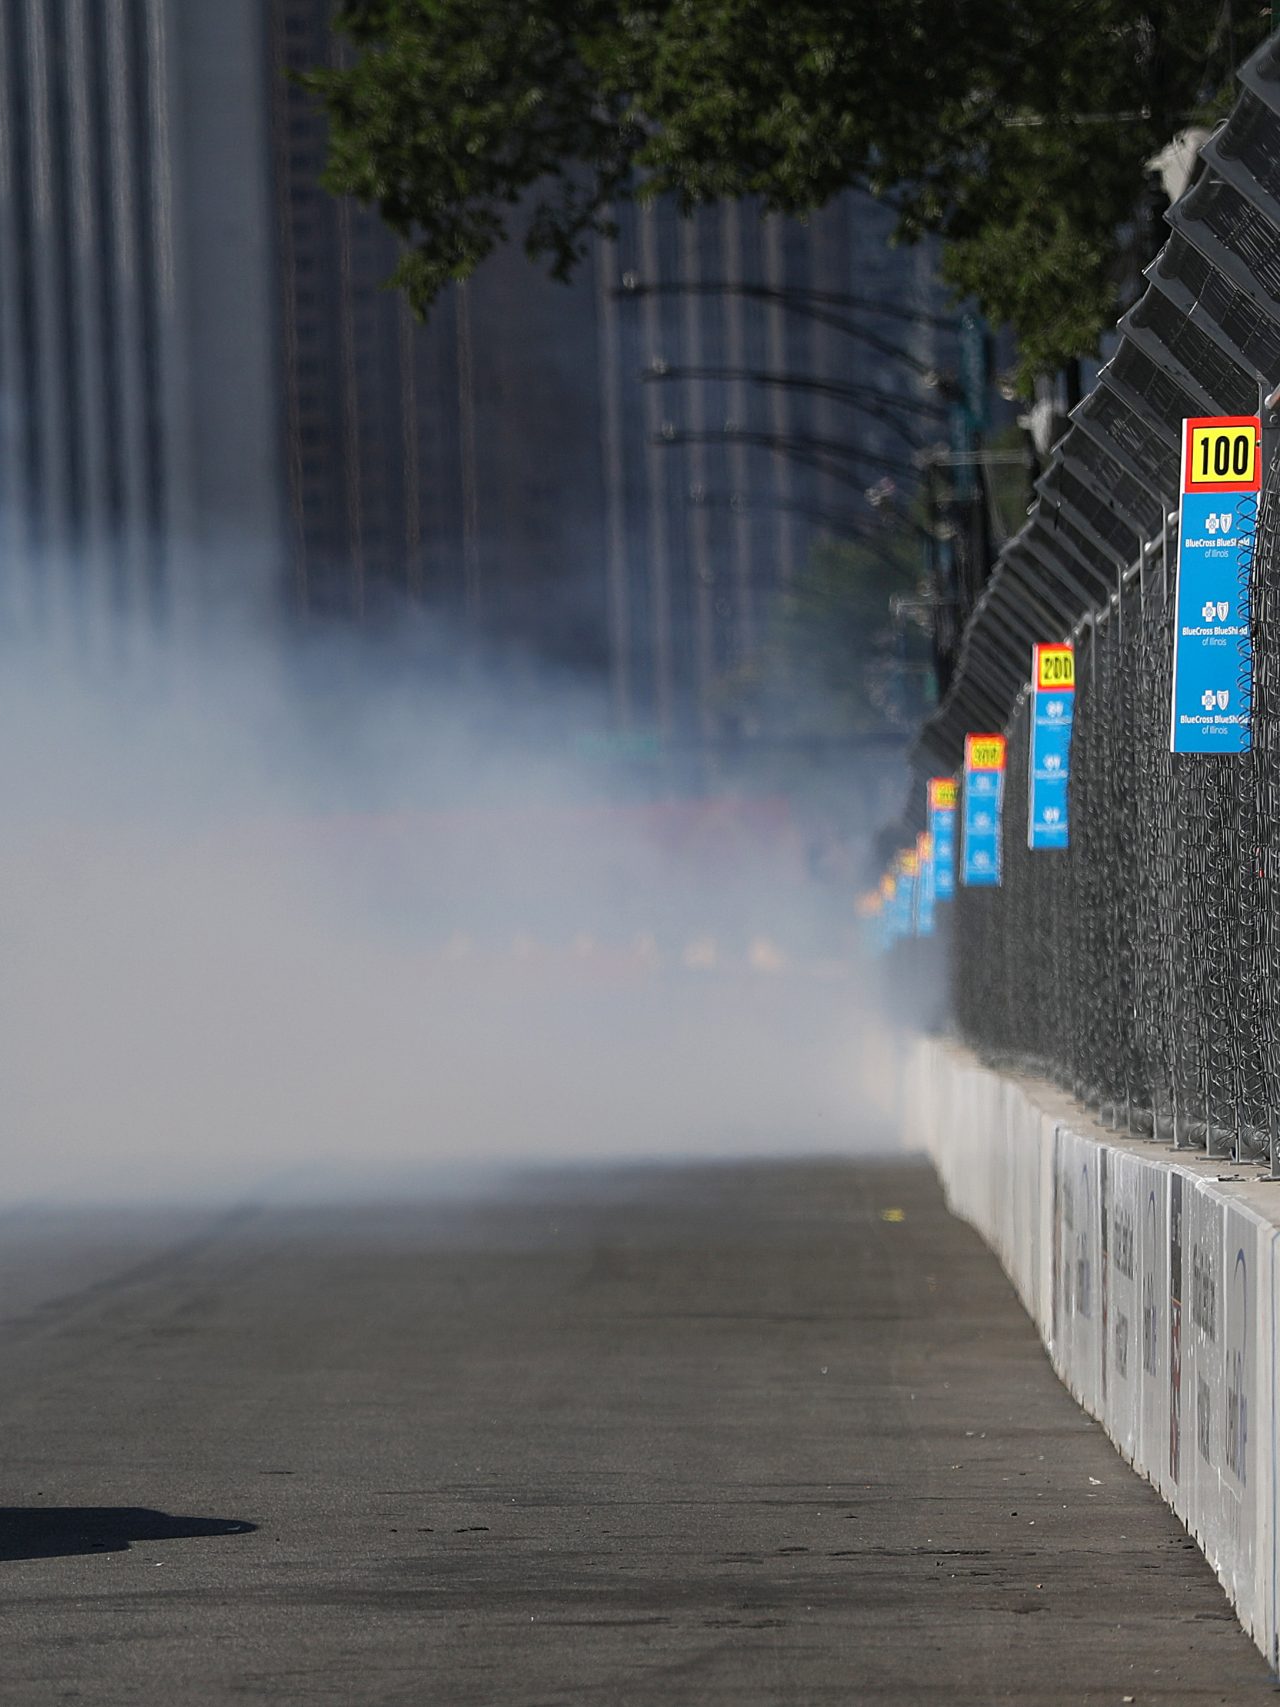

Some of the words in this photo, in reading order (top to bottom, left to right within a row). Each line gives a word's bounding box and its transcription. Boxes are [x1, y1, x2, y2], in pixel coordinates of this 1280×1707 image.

[1201, 435, 1249, 476] 100
[1185, 538, 1215, 548] BlueCross
[1216, 537, 1251, 548] BlueSheld
[1204, 549, 1212, 559] of
[1212, 549, 1229, 558] Illinois
[1182, 627, 1213, 636] BlueCross
[1202, 637, 1210, 646] of
[1209, 637, 1227, 646] Illinois
[1043, 657, 1073, 680] 200
[1180, 715, 1214, 724] BlueCross
[1202, 726, 1210, 735] of
[1210, 726, 1228, 735] Illinois
